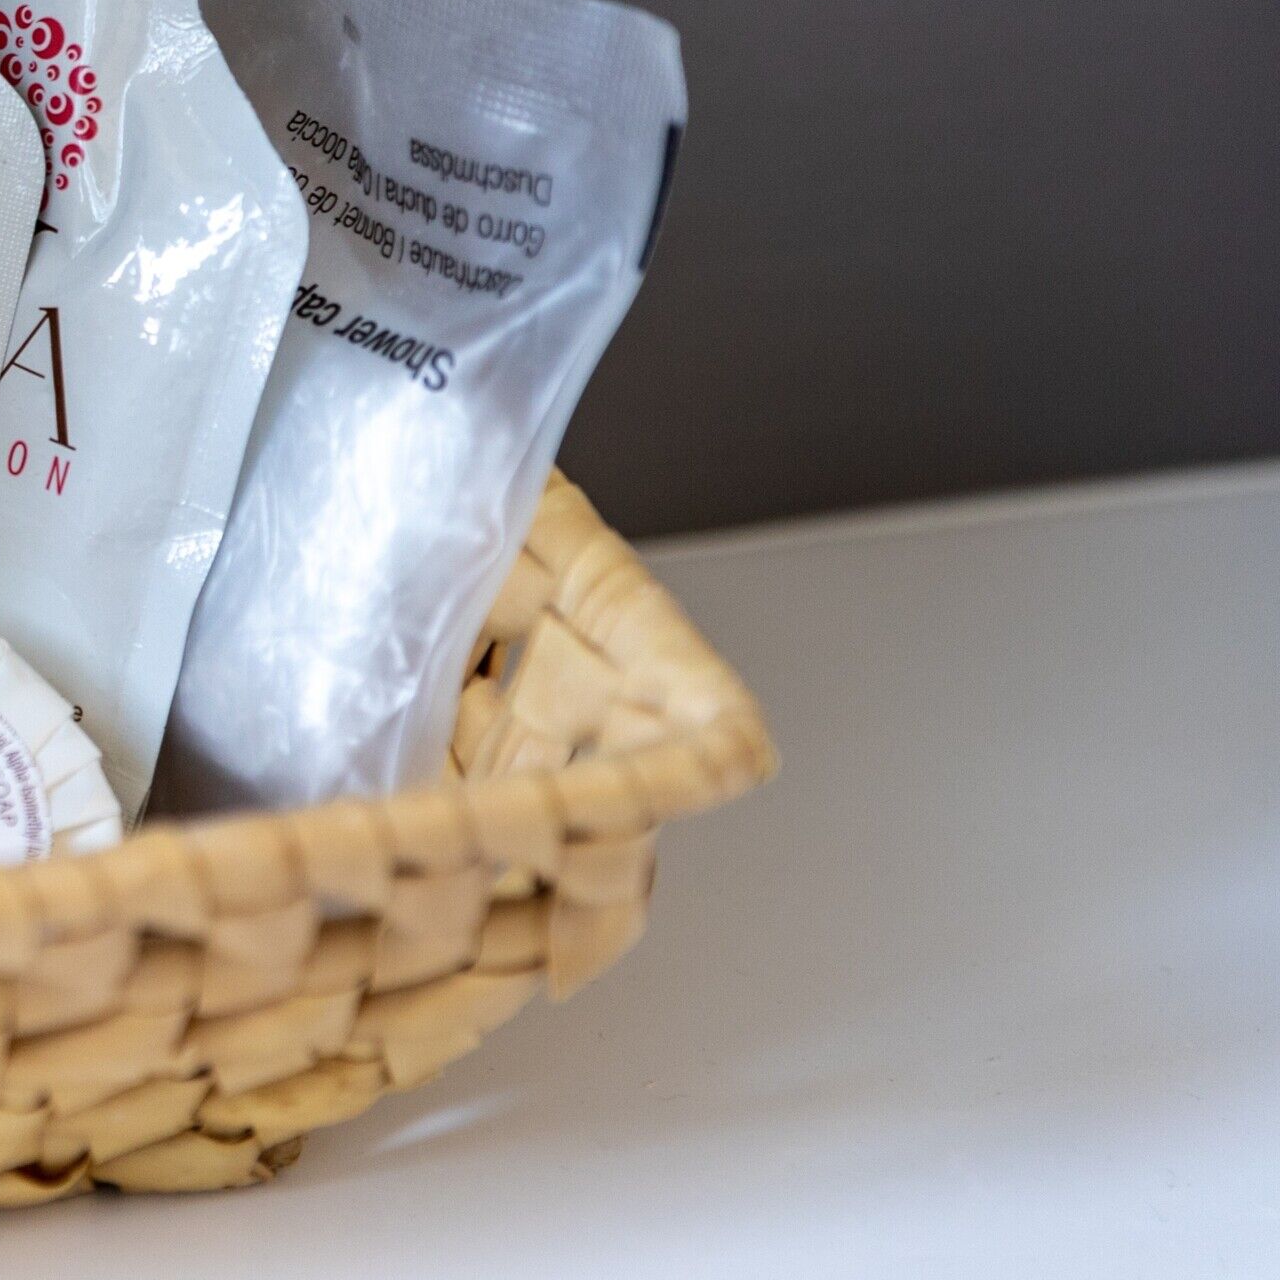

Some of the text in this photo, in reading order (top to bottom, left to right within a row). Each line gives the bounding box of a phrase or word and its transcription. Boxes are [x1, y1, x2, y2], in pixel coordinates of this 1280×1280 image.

[286, 110, 348, 163] doccia
[410, 137, 553, 208] Duschmössa
[307, 186, 338, 215] de
[386, 176, 437, 224] ducha
[443, 202, 469, 236] de
[333, 201, 395, 258] Bonnet
[477, 214, 546, 258] Gorro
[334, 316, 456, 392] Shower
